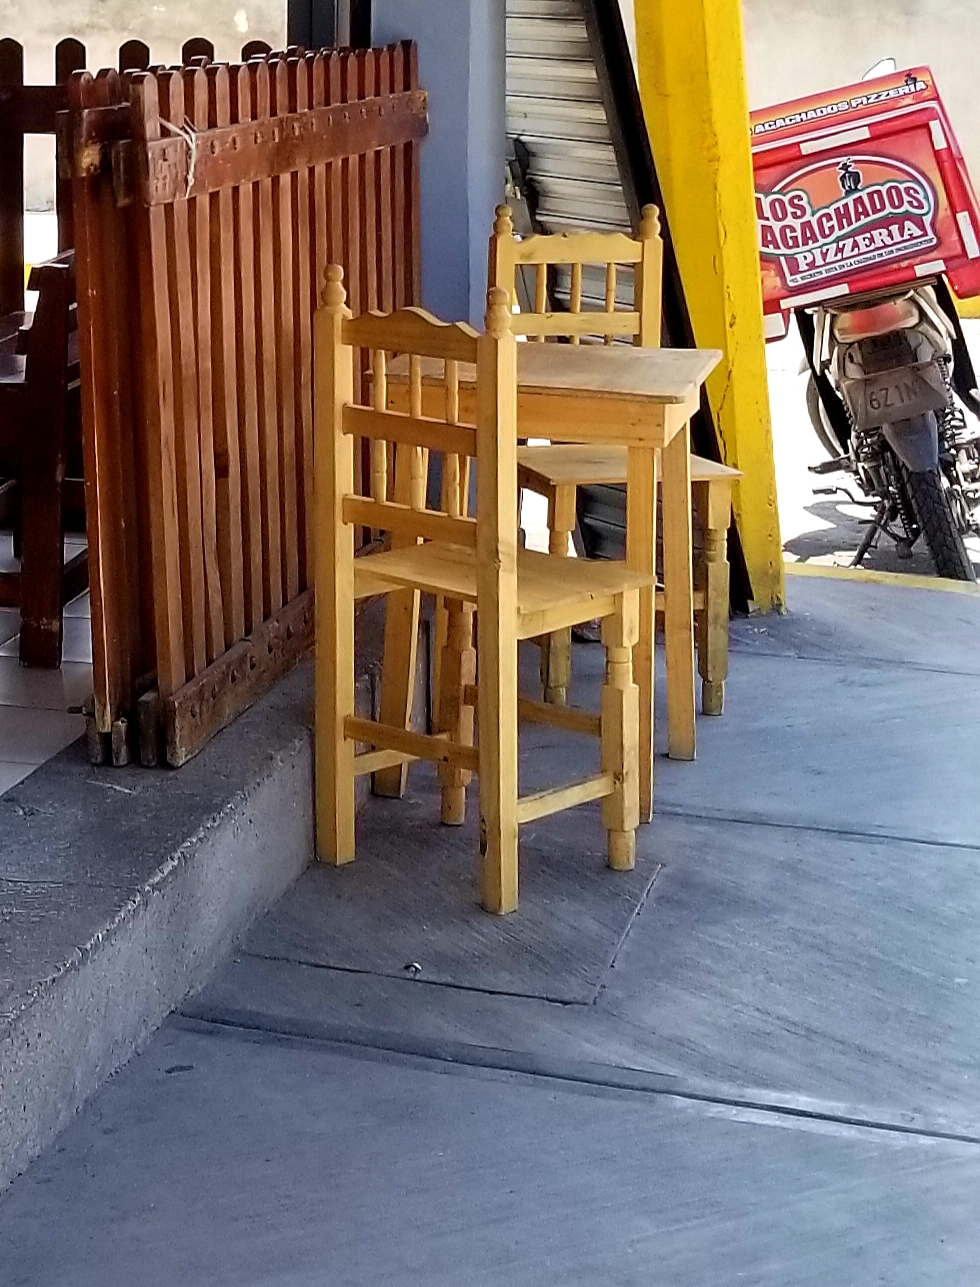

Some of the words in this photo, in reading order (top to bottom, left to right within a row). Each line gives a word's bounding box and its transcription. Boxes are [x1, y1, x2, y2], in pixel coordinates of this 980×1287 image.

[754, 100, 849, 135] AGACHADOS
[756, 193, 807, 223] LOS
[760, 184, 925, 251] AGACHADOS
[794, 220, 924, 273] PIZZERIA
